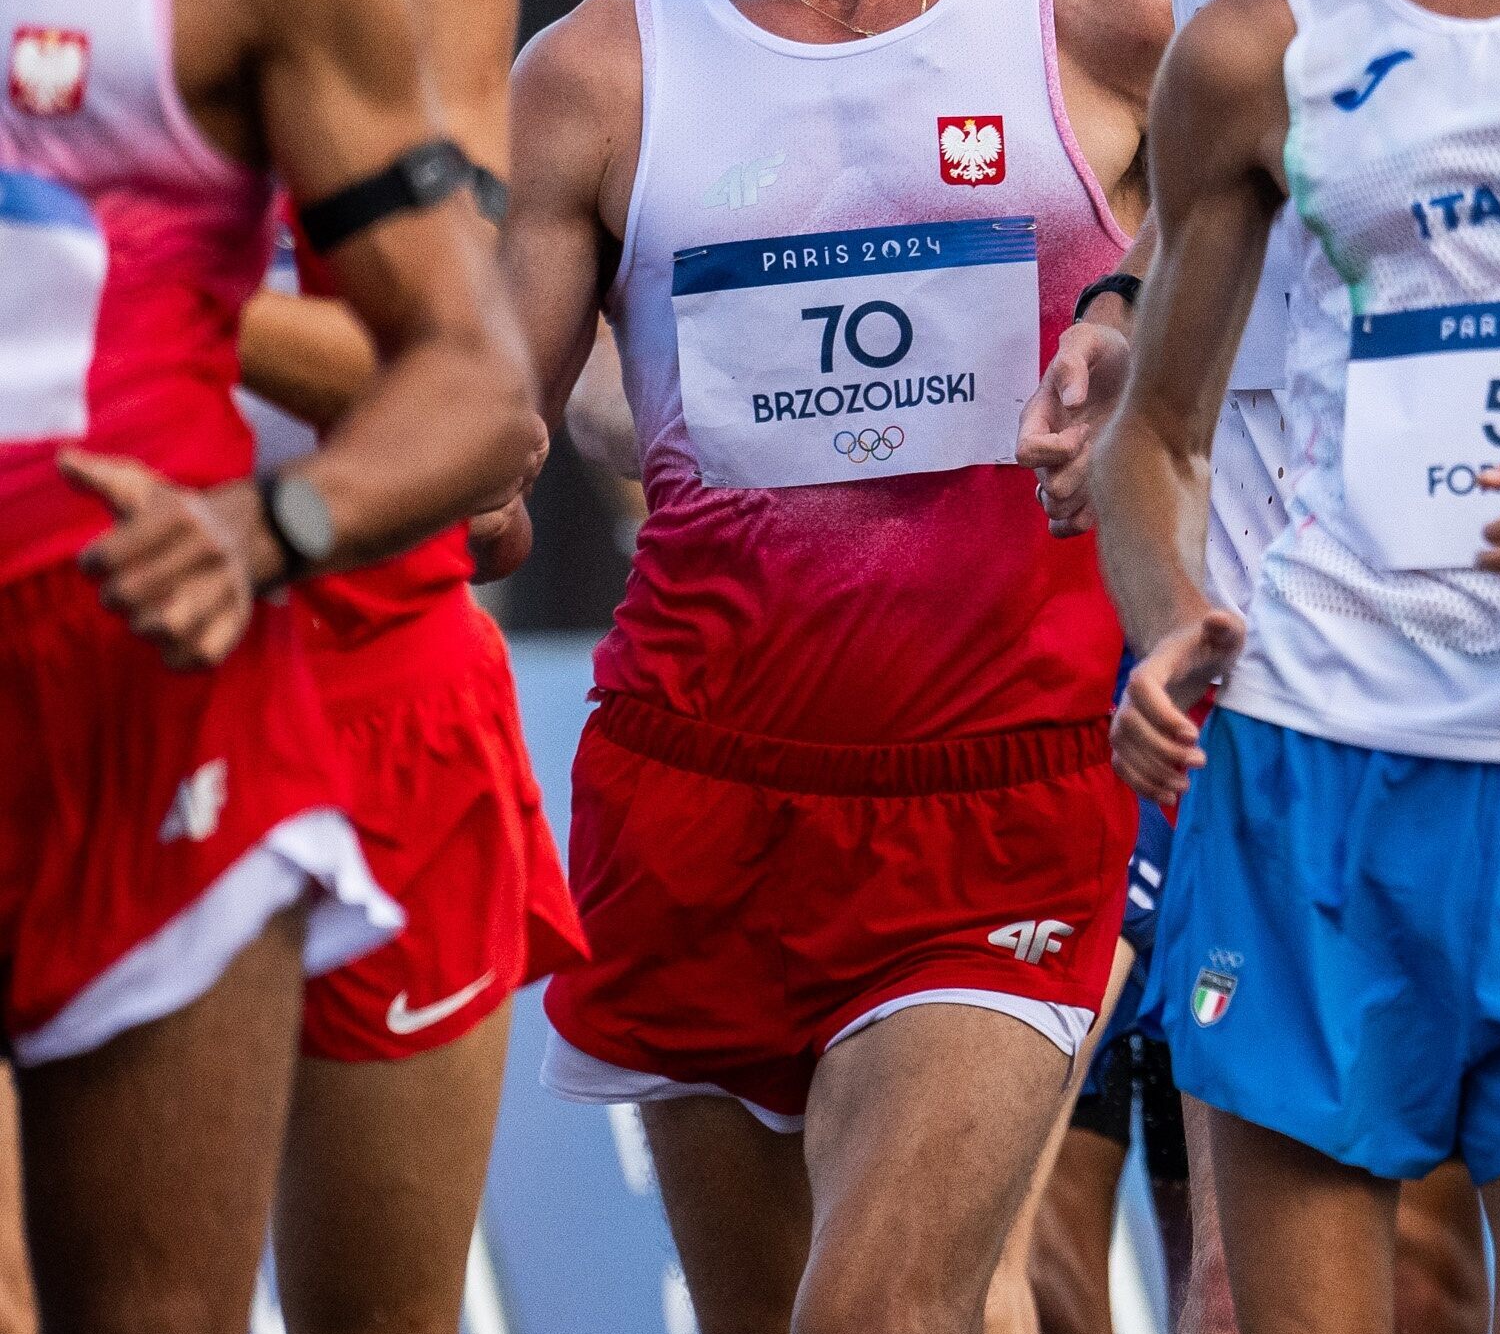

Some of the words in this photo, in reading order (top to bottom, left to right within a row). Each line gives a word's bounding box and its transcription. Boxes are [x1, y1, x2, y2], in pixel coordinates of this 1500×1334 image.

[762, 244, 850, 272] PARIS
[861, 236, 943, 264] 2024
[800, 299, 914, 374] 70
[751, 372, 976, 425] BRZOZOWSKI
[987, 918, 1076, 966] 4F
